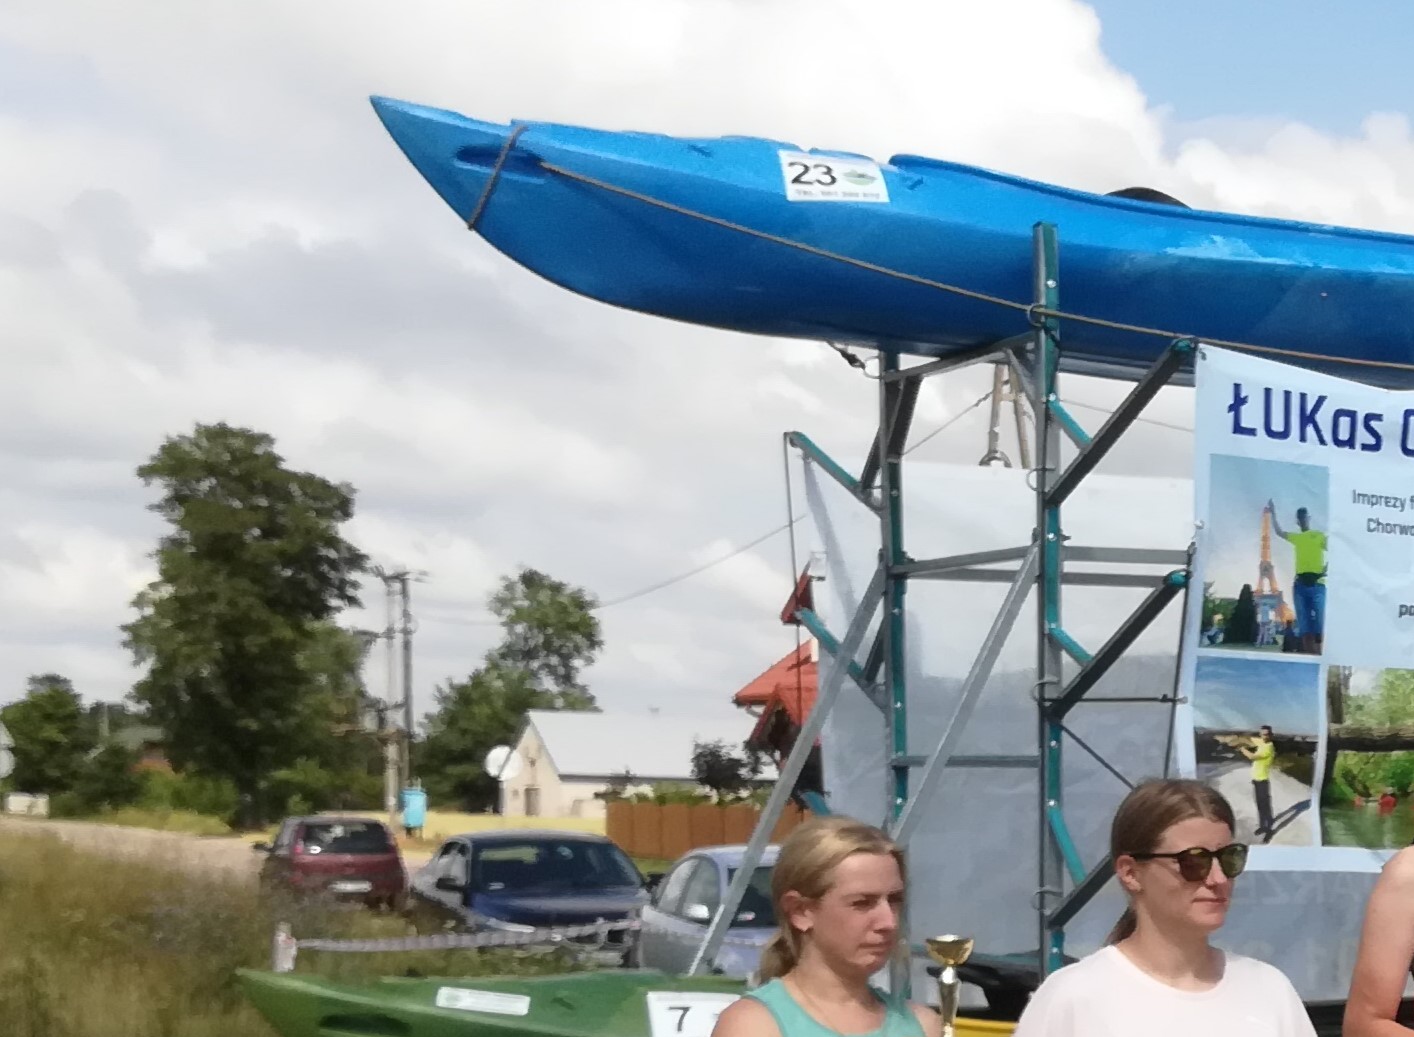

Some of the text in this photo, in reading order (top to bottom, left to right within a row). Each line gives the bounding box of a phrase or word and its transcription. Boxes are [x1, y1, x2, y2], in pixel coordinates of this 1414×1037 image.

[787, 161, 837, 187] 23
[1228, 383, 1384, 452] ŁUKas
[1352, 489, 1407, 512] Imprezy
[666, 1005, 691, 1033] 7
